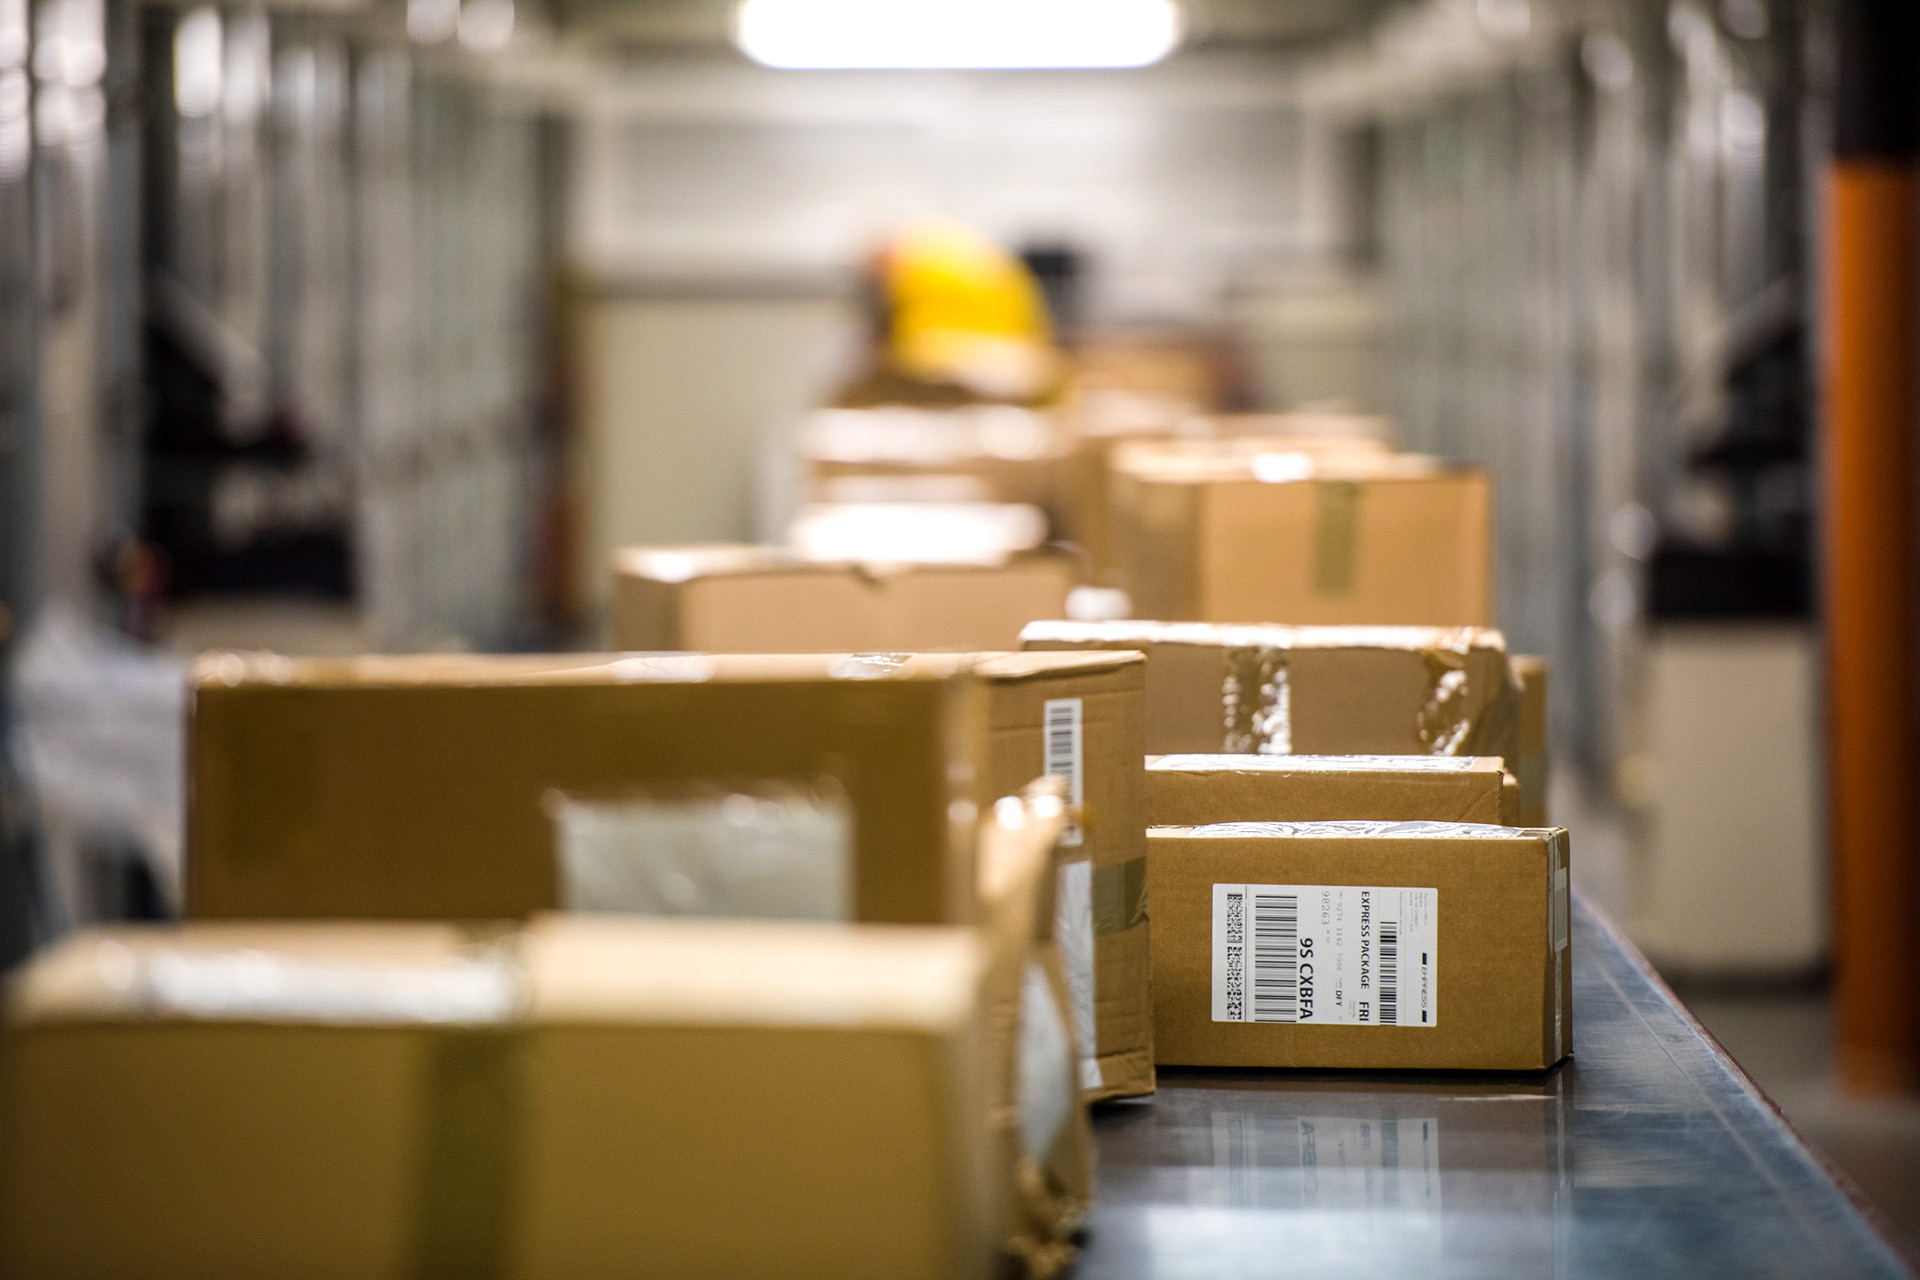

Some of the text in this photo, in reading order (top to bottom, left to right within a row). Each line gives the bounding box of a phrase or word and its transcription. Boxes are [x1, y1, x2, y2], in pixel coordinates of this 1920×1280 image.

[1322, 890, 1330, 925] 98263
[1361, 891, 1370, 989] EXPRESS PACKAGE
[1300, 938, 1313, 1019] 9S CXBFA
[1359, 1002, 1369, 1021] FRI
